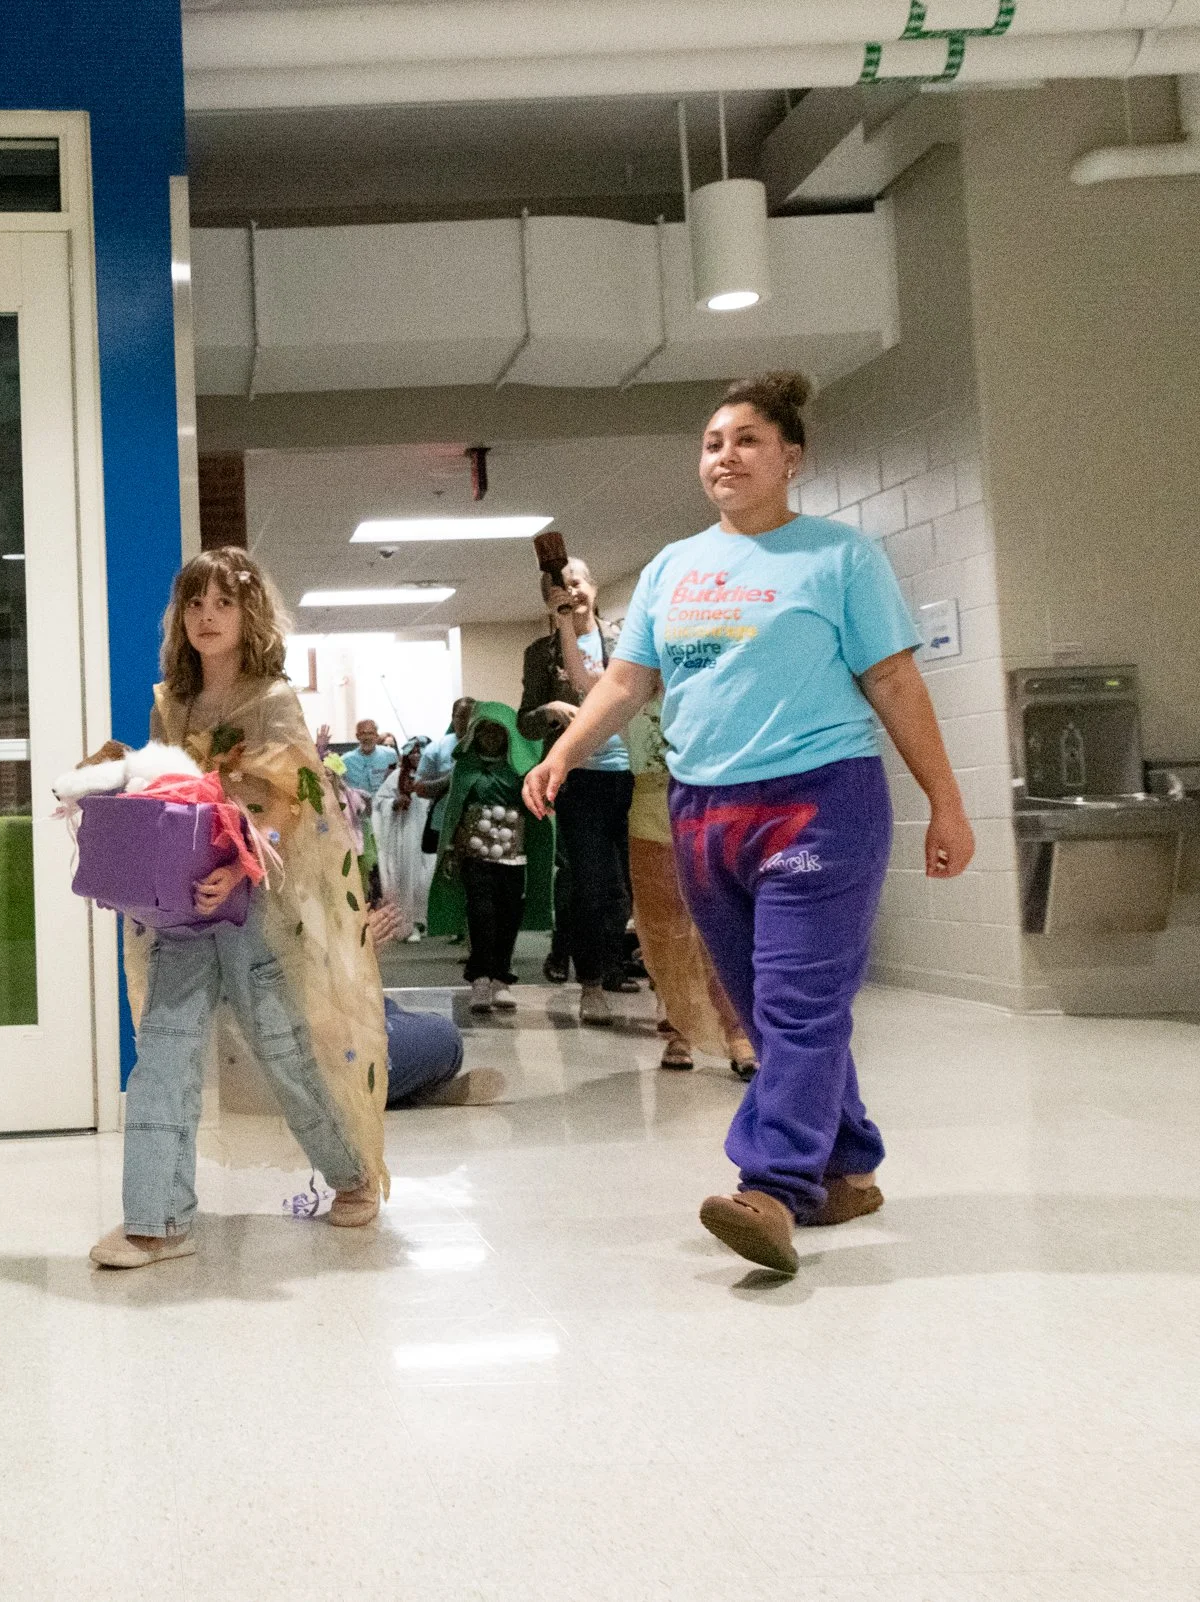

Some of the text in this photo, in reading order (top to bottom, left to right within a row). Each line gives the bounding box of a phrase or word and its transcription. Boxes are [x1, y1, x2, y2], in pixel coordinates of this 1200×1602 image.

[679, 569, 729, 586] Art
[671, 586, 777, 605] Buddies
[667, 607, 743, 622] Connect
